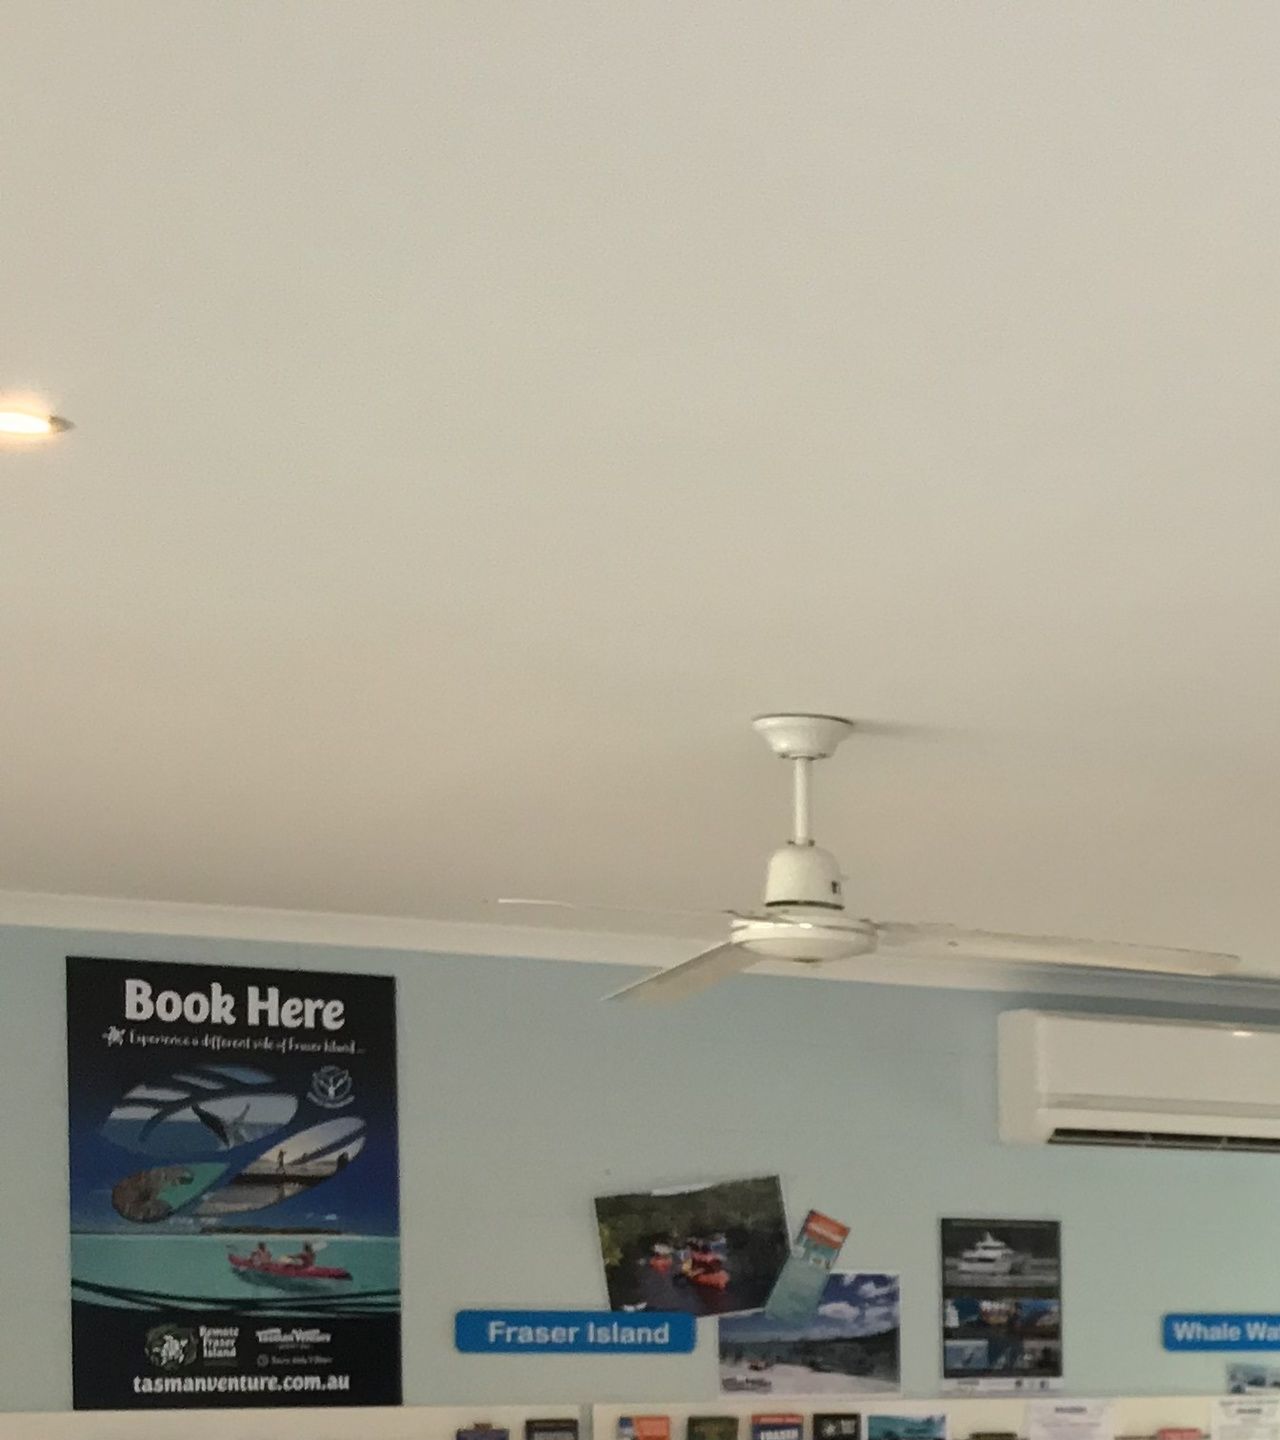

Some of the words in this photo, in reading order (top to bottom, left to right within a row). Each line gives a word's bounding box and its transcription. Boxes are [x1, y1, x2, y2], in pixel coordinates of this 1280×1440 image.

[124, 978, 237, 1026] Book
[247, 986, 346, 1031] Here
[199, 1325, 240, 1338] Remote
[487, 1320, 580, 1345] Fraser
[587, 1321, 670, 1345] Island
[1172, 1320, 1242, 1343] Whale
[203, 1346, 236, 1358] Island
[133, 1374, 350, 1394] tasmanventure.com.au
